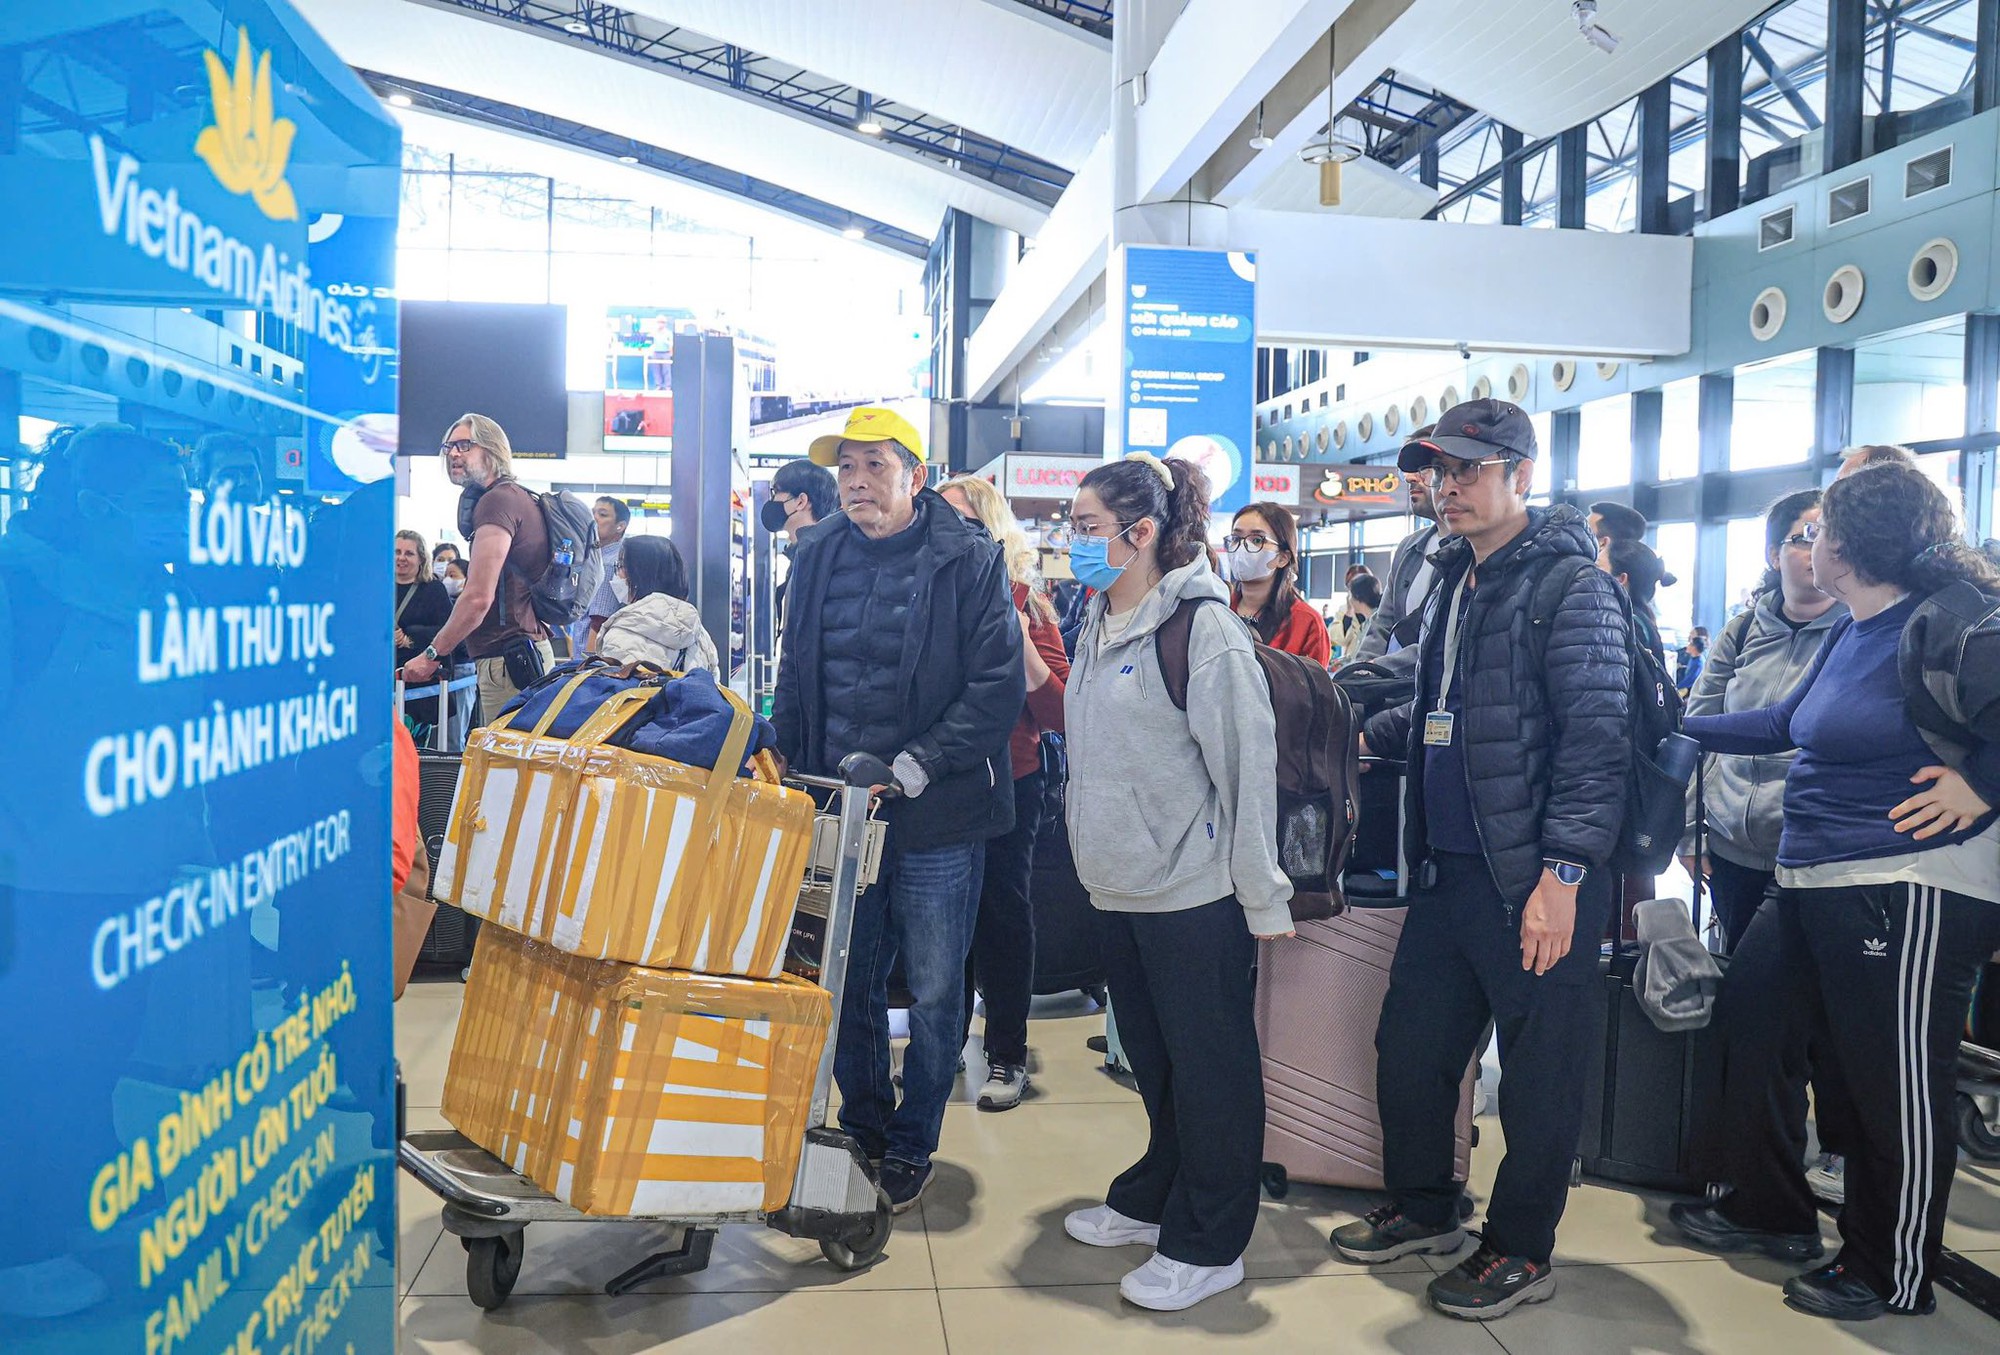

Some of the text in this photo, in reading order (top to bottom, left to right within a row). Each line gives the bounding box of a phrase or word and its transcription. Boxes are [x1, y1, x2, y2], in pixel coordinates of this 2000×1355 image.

[90, 134, 257, 304] Vietnam
[189, 479, 307, 568] LỐI VÀO
[138, 586, 335, 684] LÀM THỦ TỤC
[84, 680, 358, 817] CHO HÀNH KHÁCH
[91, 809, 352, 991] CHECK-IN ENTRY FOR
[89, 1137, 154, 1232] GIA
[158, 1069, 233, 1177] ĐÌNH
[235, 1029, 272, 1106] CÓ
[272, 991, 311, 1074] TRẺ
[245, 1122, 336, 1255] CHECK-IN
